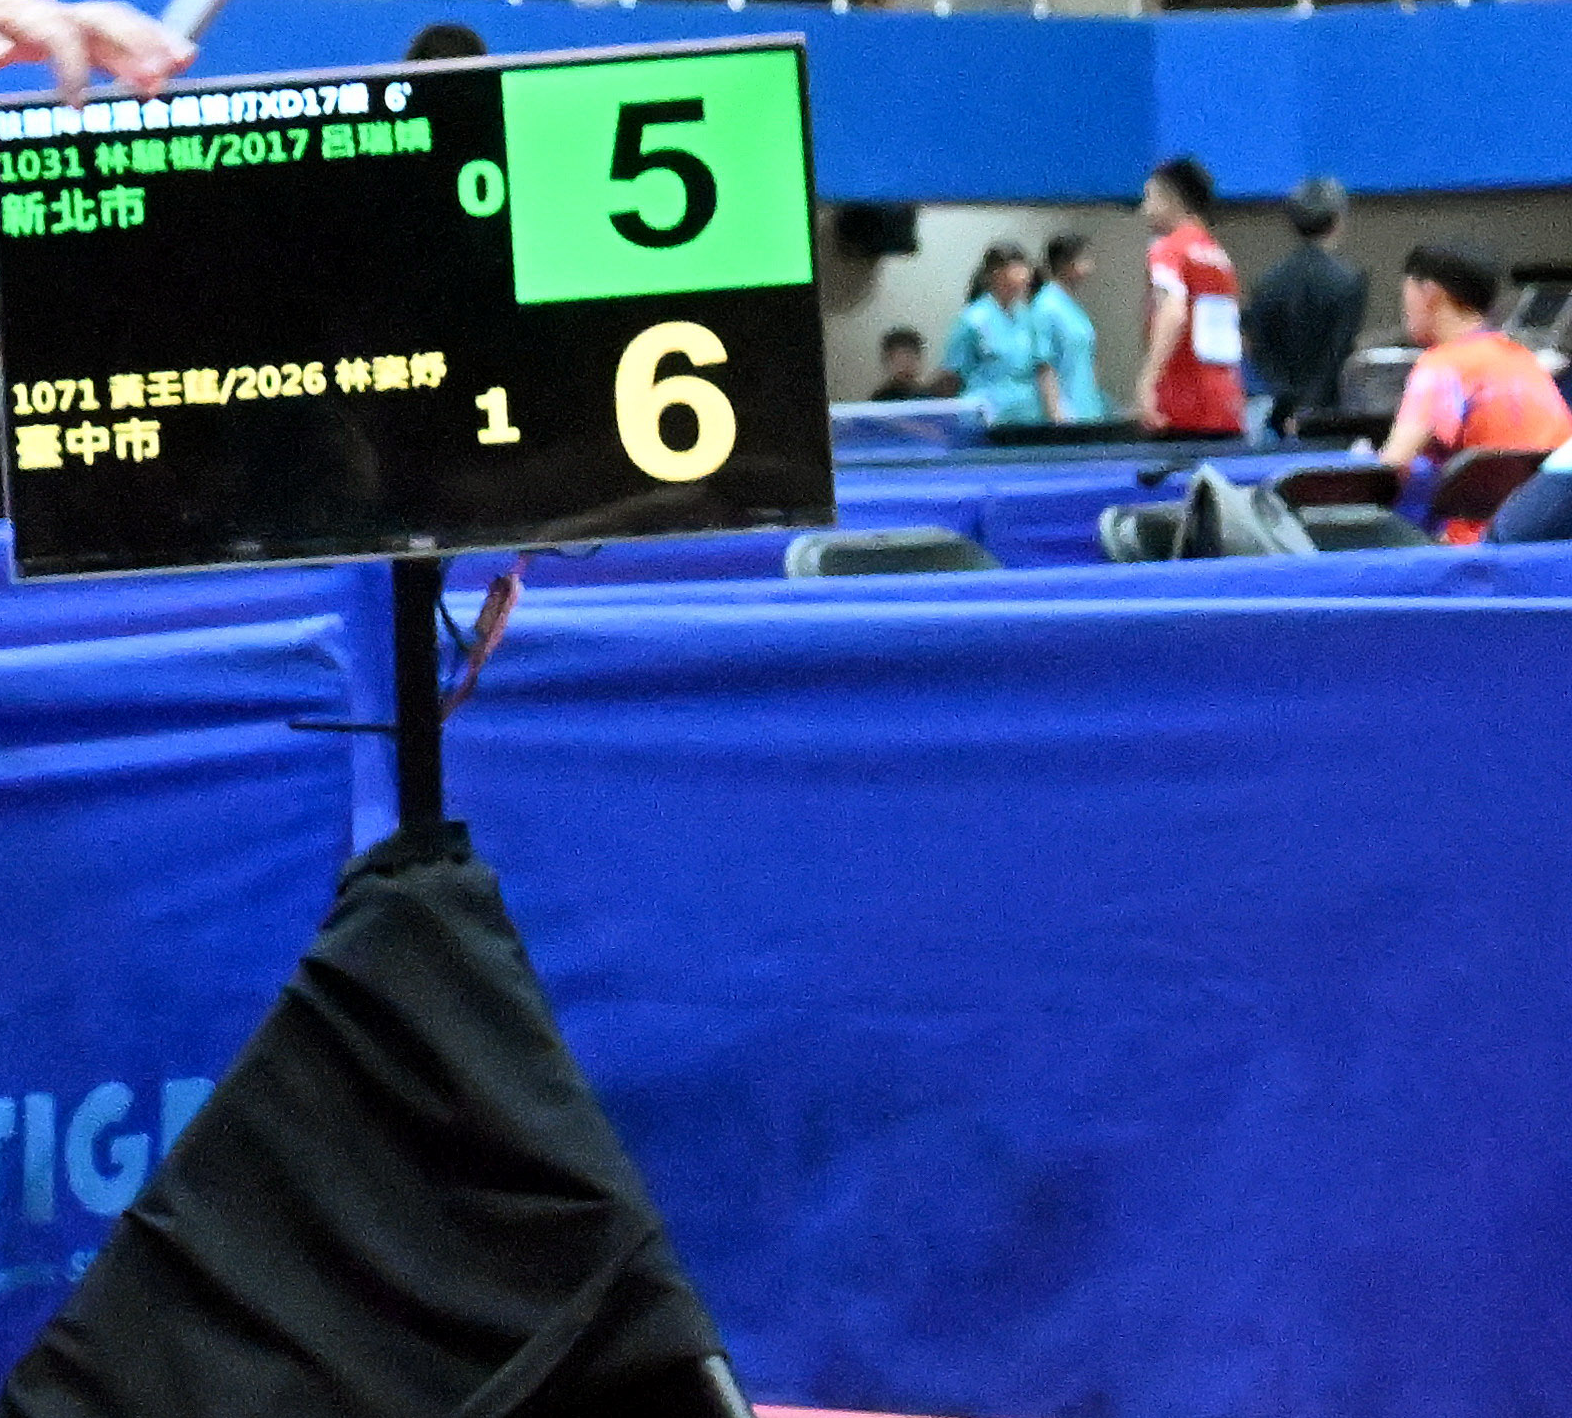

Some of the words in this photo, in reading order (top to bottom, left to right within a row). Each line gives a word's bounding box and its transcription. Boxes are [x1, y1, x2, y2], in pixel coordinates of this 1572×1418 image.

[457, 158, 506, 218] 0
[609, 97, 718, 249] 5
[0, 183, 147, 238] 新北市
[11, 378, 101, 416] 1071
[475, 385, 521, 445] 1
[615, 320, 737, 483] 6
[14, 417, 162, 471] 臺中市
